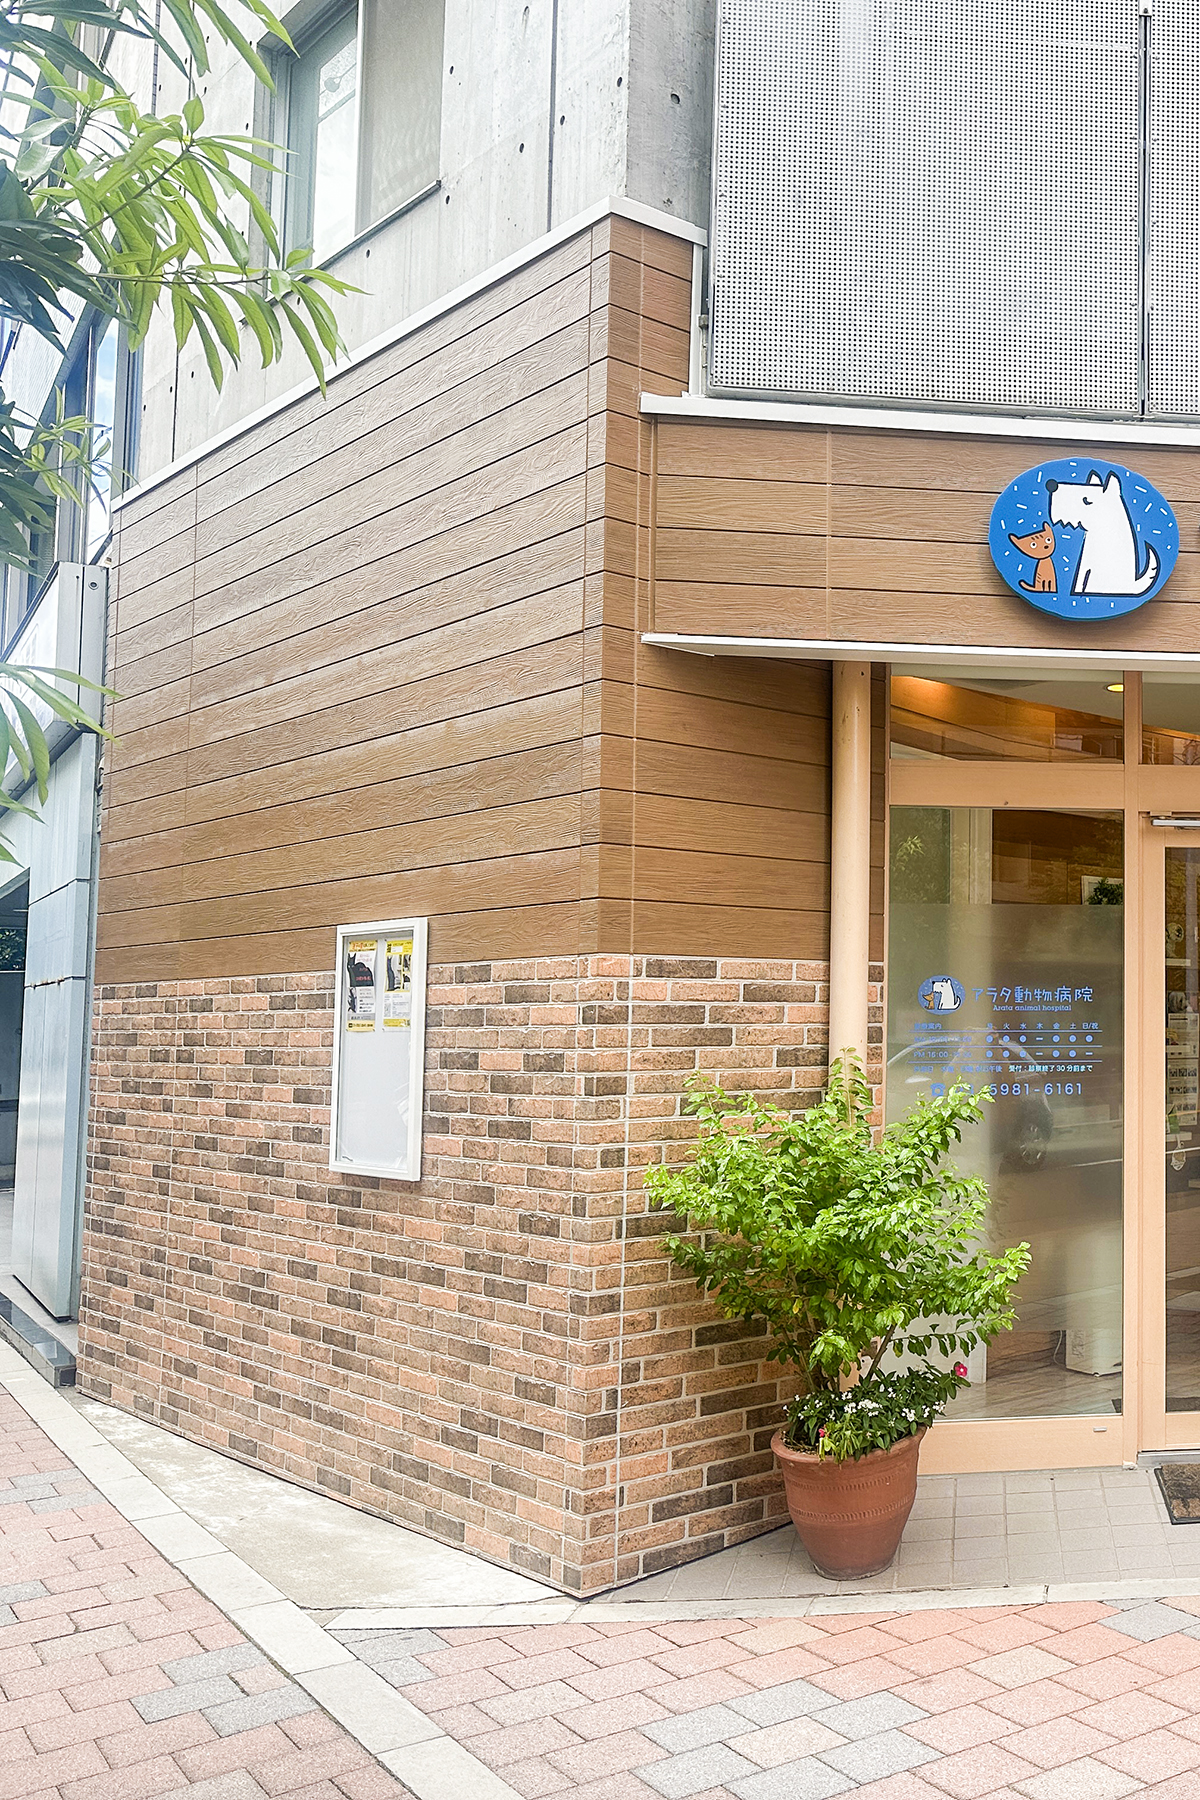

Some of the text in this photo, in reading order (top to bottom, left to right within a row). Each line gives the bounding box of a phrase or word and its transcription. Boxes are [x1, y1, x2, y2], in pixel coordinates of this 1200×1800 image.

[971, 985, 1093, 1003] アラタ動物病院
[1042, 1004, 1072, 1012] hospital
